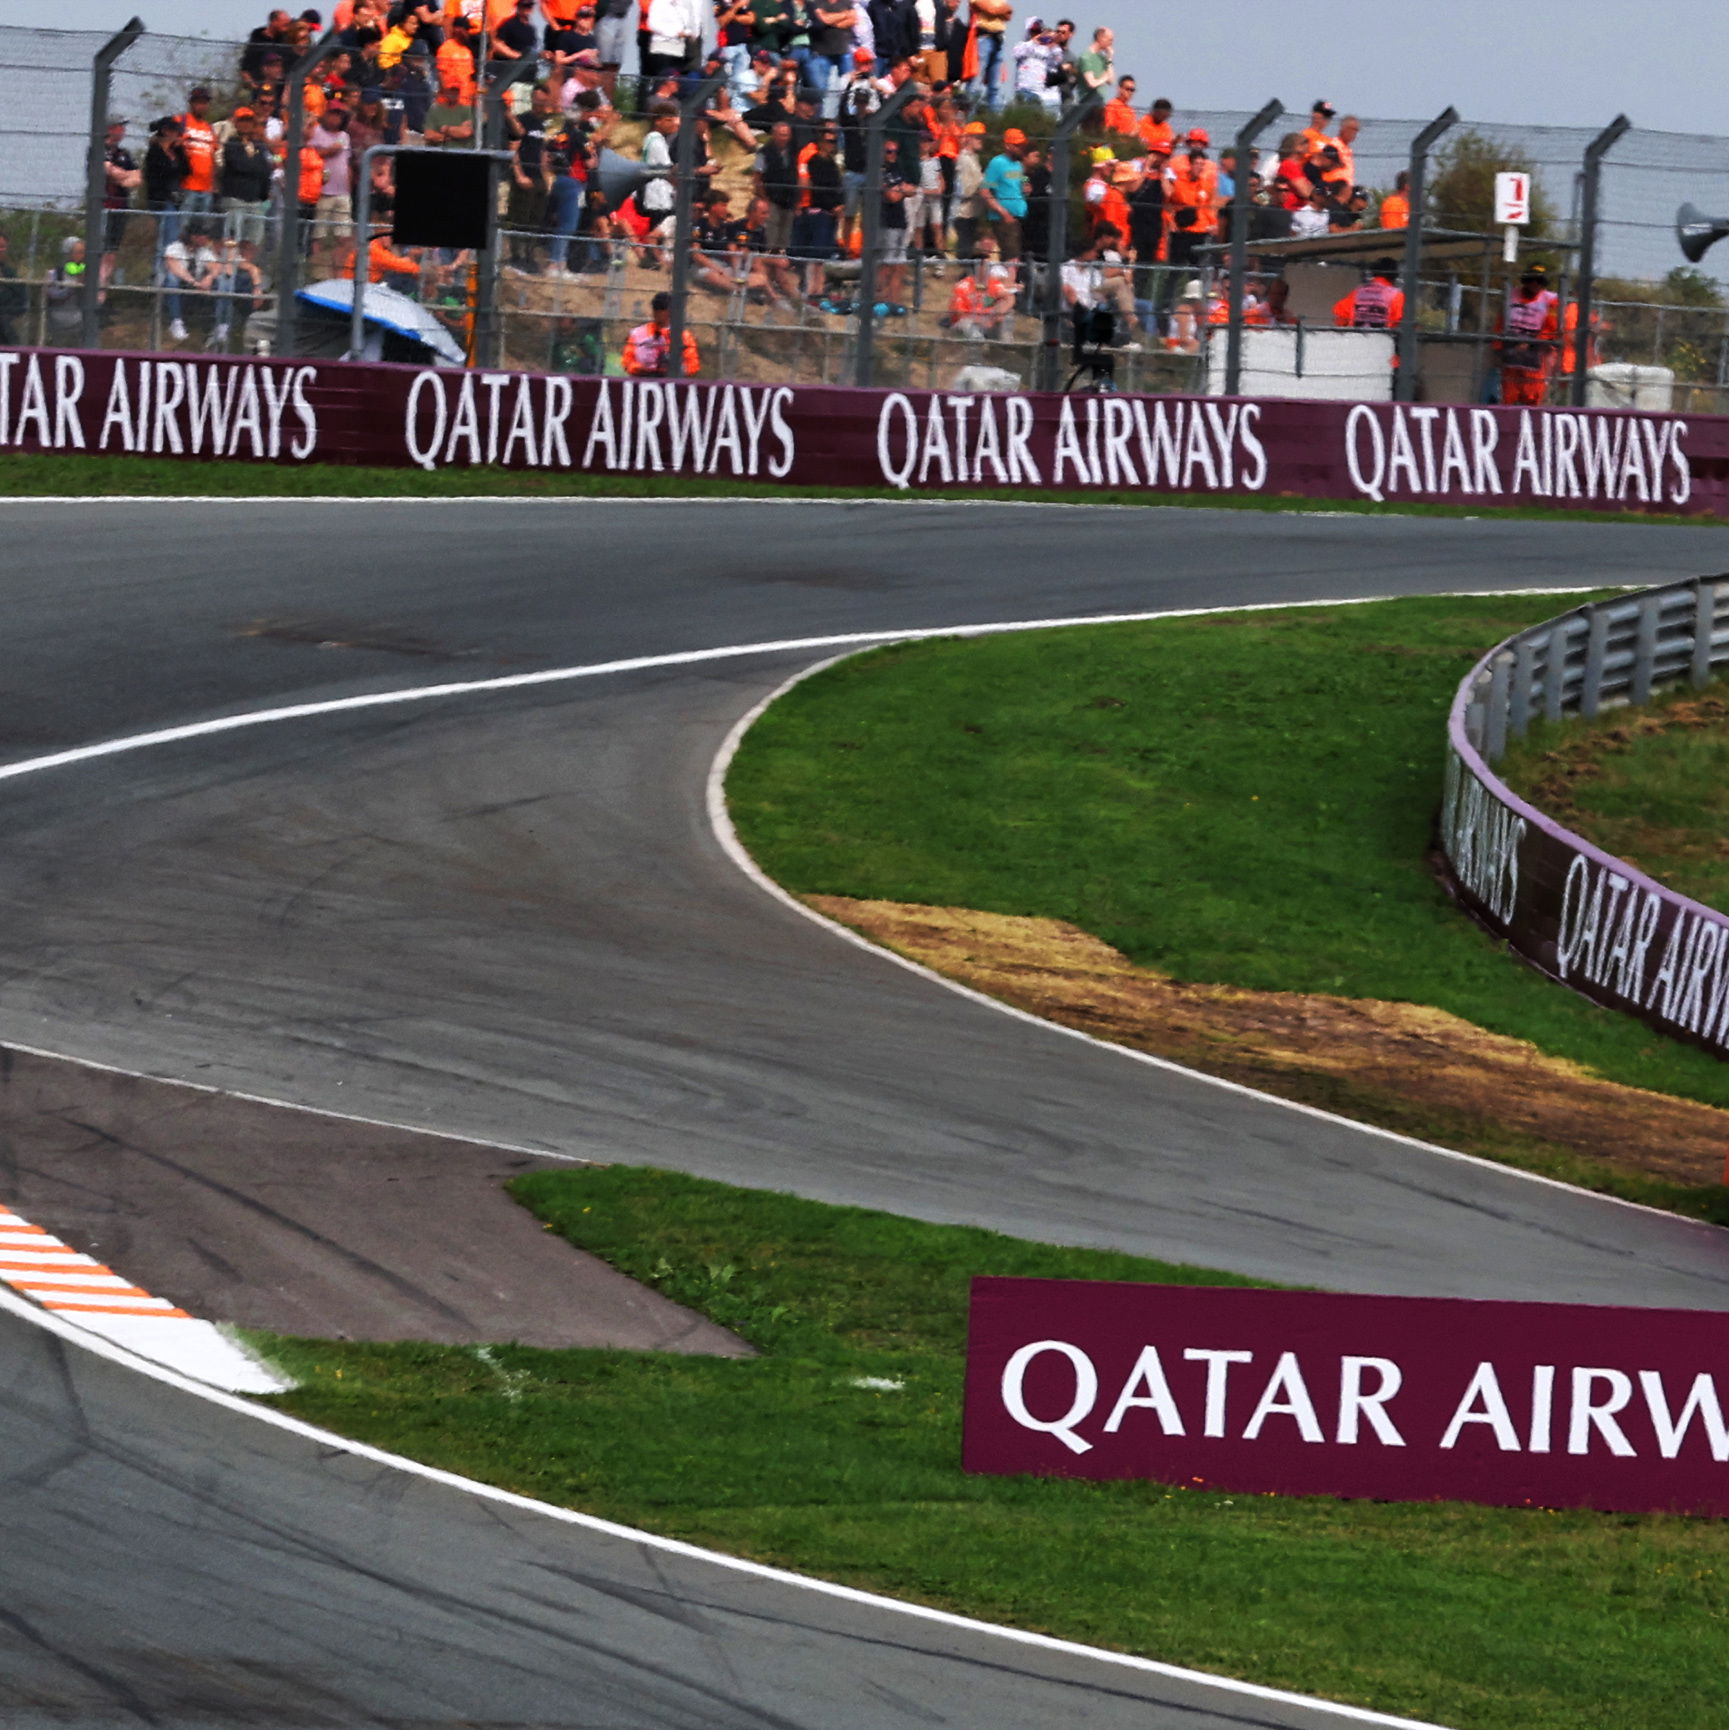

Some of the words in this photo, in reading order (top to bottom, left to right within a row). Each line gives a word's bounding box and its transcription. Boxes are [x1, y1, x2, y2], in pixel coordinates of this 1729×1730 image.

[99, 358, 317, 459] AIRWAYS
[406, 370, 572, 470] QATAR
[584, 378, 794, 477] AIRWAYS
[877, 392, 1042, 489] QATAR
[1054, 396, 1266, 490] AIRWAYS
[1345, 404, 1503, 502] QATAR
[1513, 409, 1690, 504] AIRWAYS
[1556, 853, 1661, 1004] QATAR
[1001, 1340, 1406, 1455] QATAR
